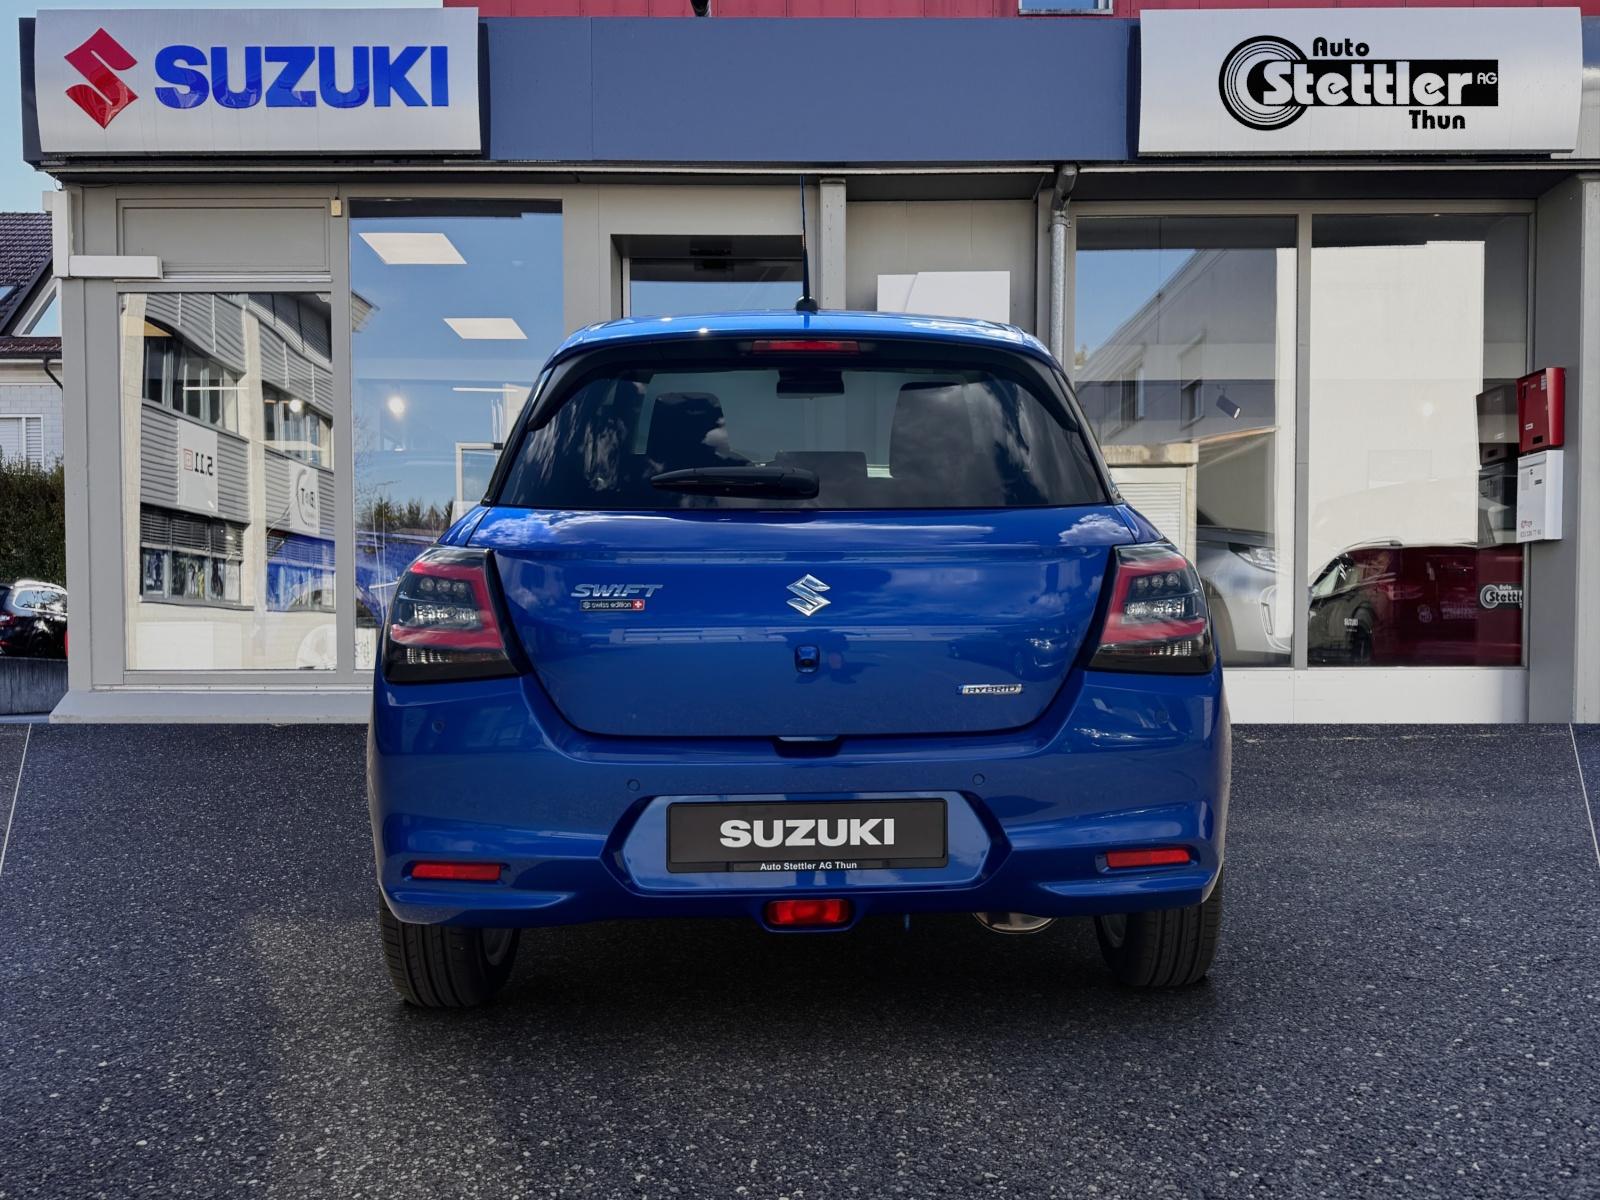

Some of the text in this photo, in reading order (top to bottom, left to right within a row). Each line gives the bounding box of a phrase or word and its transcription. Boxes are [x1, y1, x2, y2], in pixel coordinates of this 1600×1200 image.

[1312, 37, 1370, 58] Auto
[154, 44, 449, 109] SUZUKI
[1262, 60, 1498, 106] Stettler AG
[1408, 110, 1466, 130] Thun
[570, 583, 664, 598] SWIFT
[610, 601, 632, 609] edition
[966, 685, 1018, 694] HYBRID
[719, 818, 895, 848] SUZUKI
[760, 861, 857, 871] Auto Stettler AG Thun
